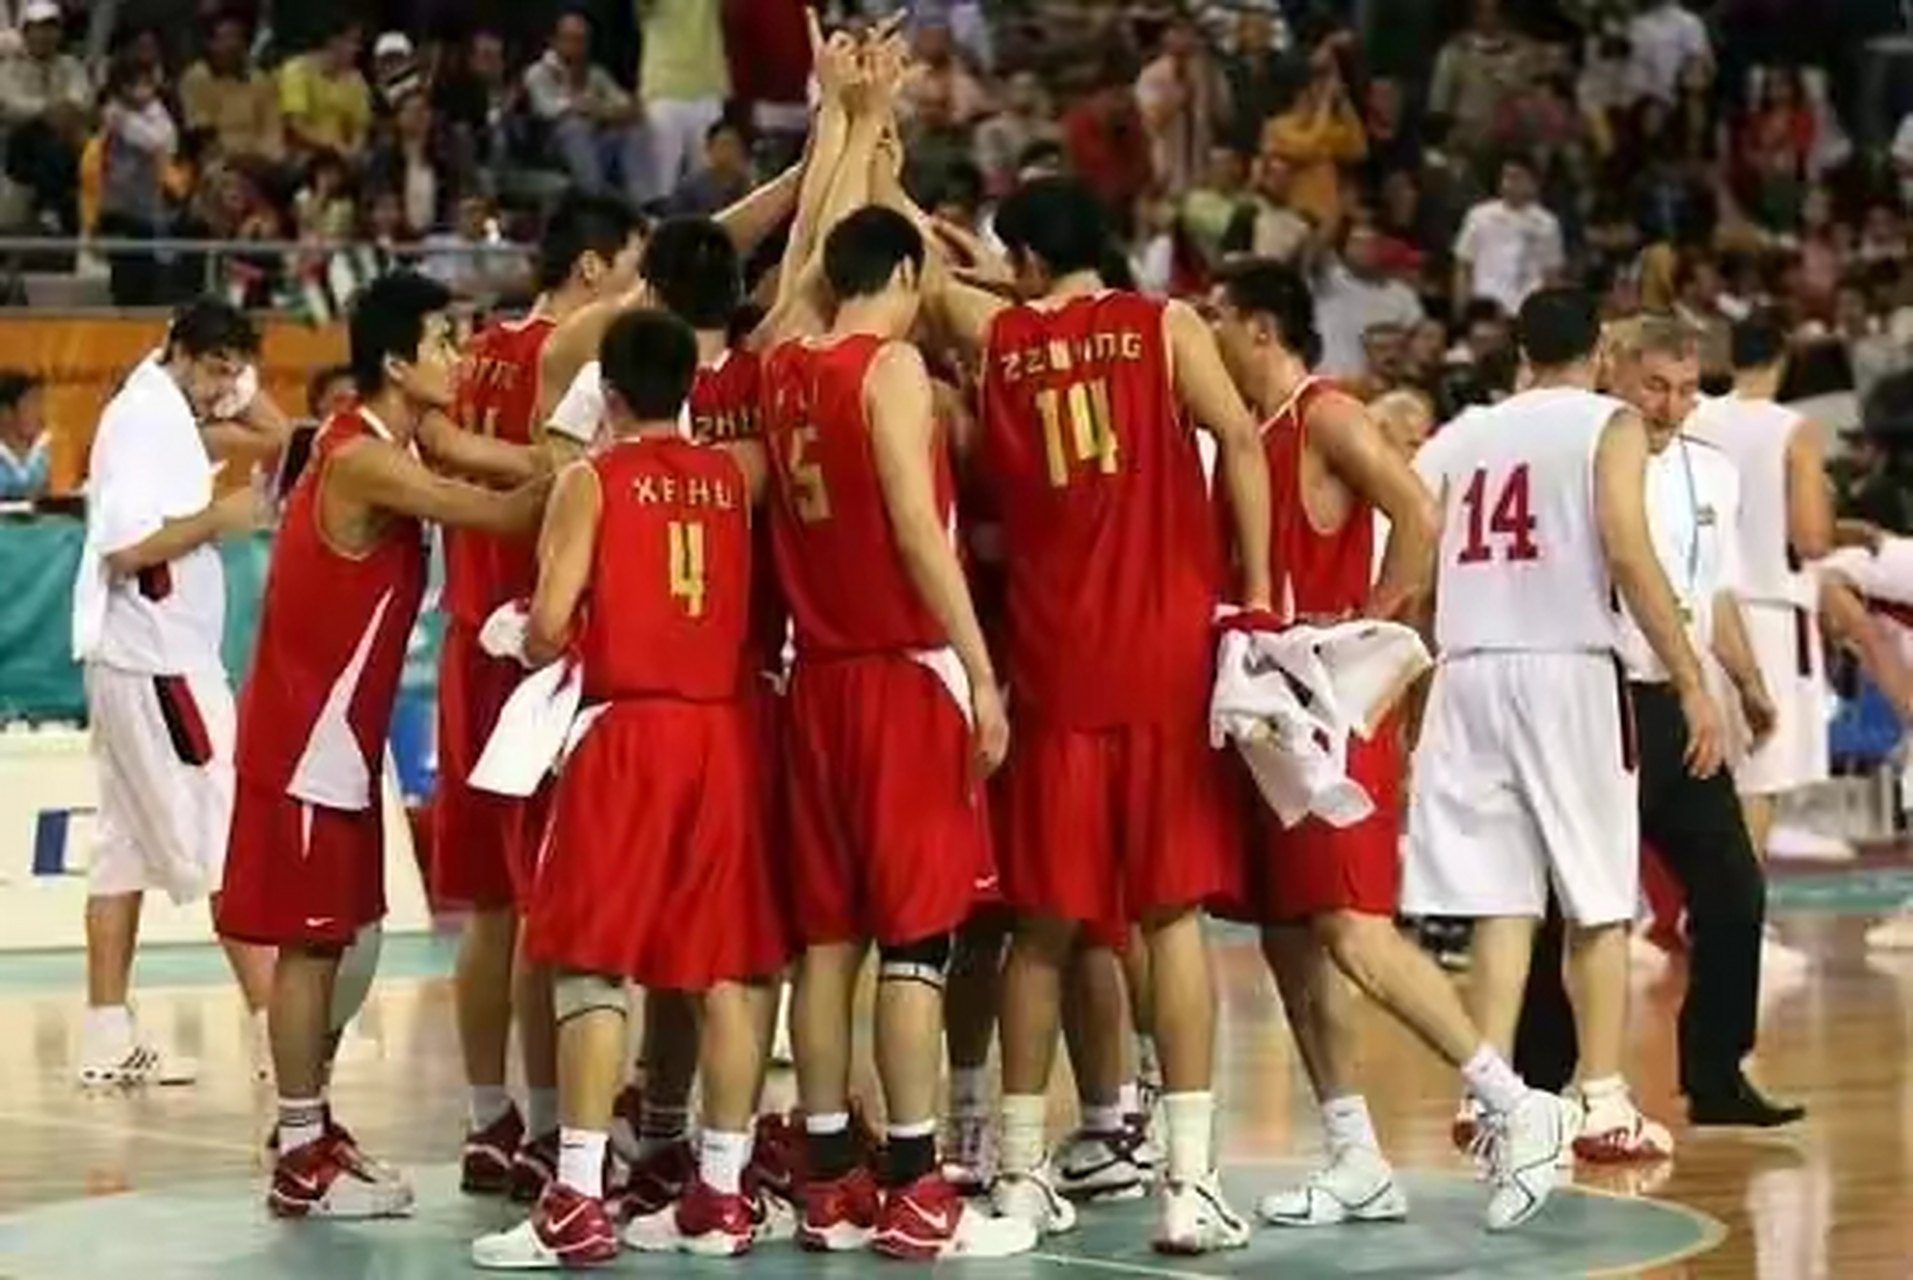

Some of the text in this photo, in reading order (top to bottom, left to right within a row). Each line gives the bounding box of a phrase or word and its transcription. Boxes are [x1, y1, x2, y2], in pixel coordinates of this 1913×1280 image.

[1036, 376, 1118, 488] 14
[1457, 463, 1539, 565] 14
[668, 520, 704, 617] 4
